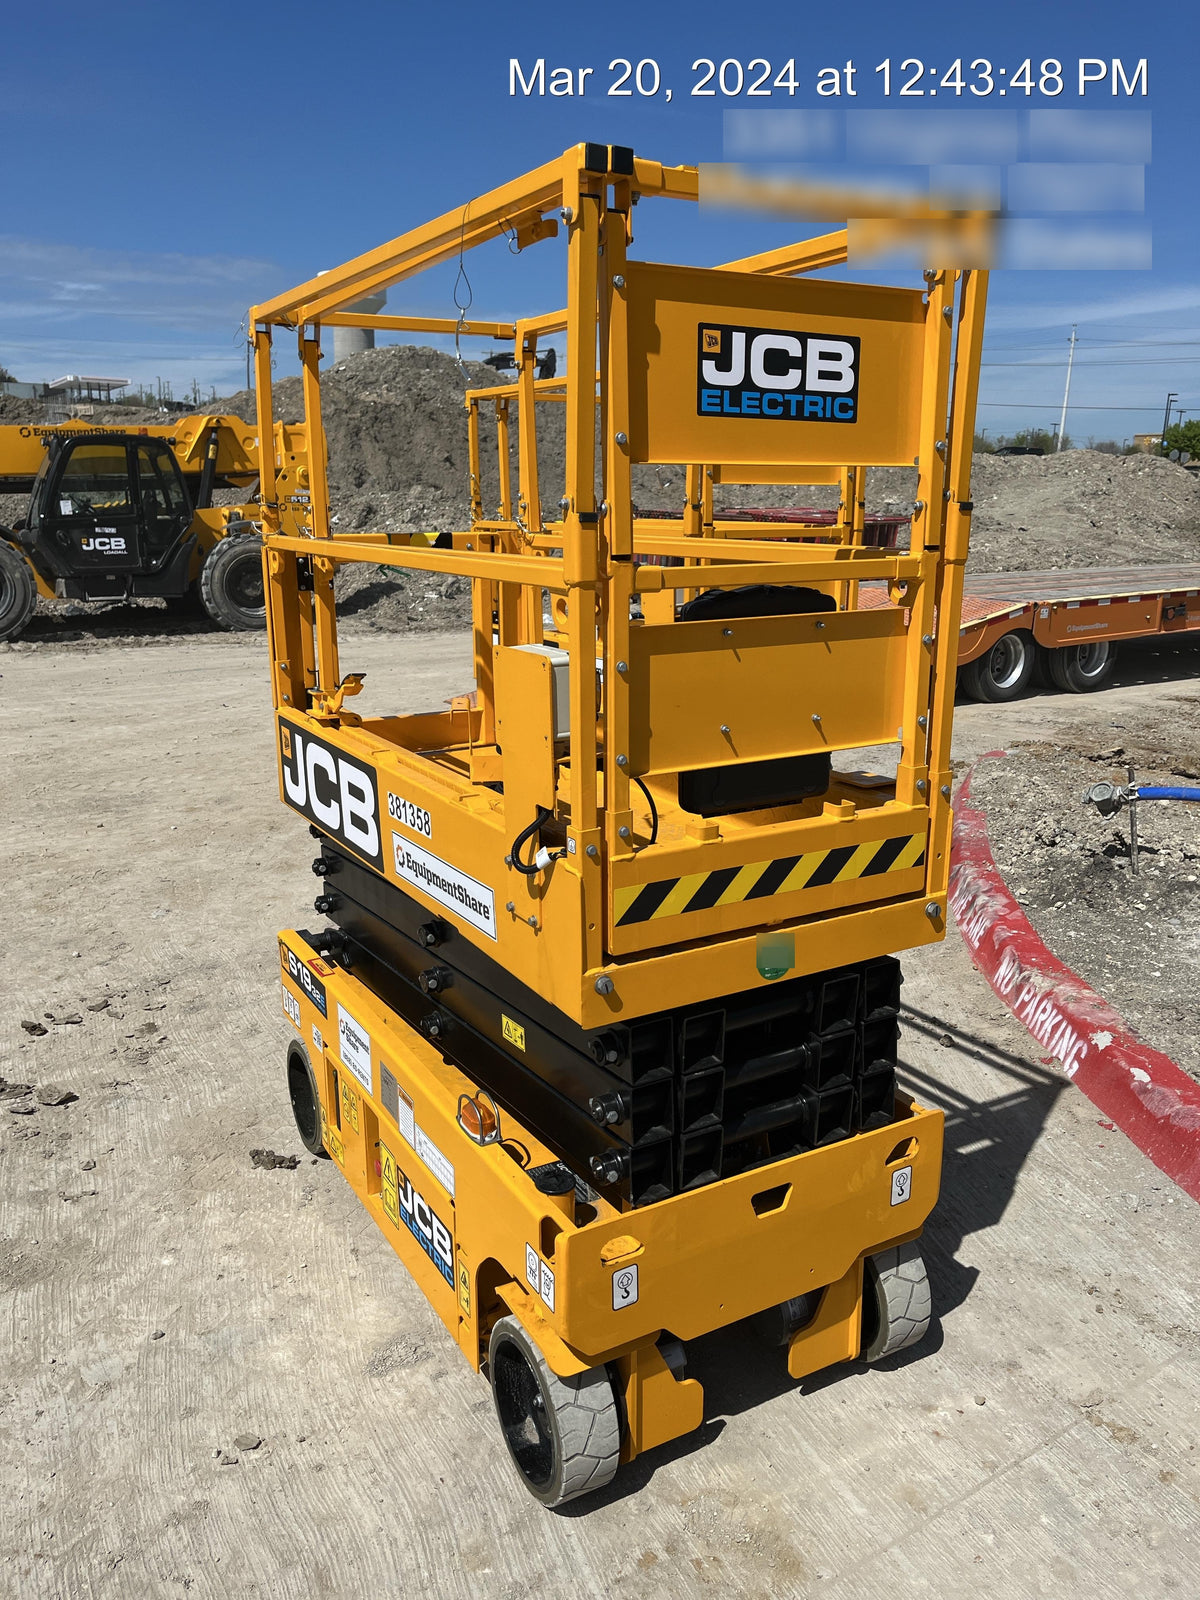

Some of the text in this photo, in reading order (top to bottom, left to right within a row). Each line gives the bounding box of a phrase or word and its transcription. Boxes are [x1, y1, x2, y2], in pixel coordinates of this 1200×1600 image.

[702, 331, 855, 393] JCB
[33, 427, 126, 438] EquipmentShare
[701, 388, 854, 419] ELECTRIC
[82, 537, 126, 551] JCB
[284, 733, 379, 858] JCB
[388, 792, 431, 837] 381358
[405, 851, 491, 921] EquipmentShare
[993, 956, 1020, 995] NO
[1014, 982, 1088, 1079] PARKING
[398, 1180, 453, 1267] JCB
[400, 1203, 454, 1287] ELECTRIC
